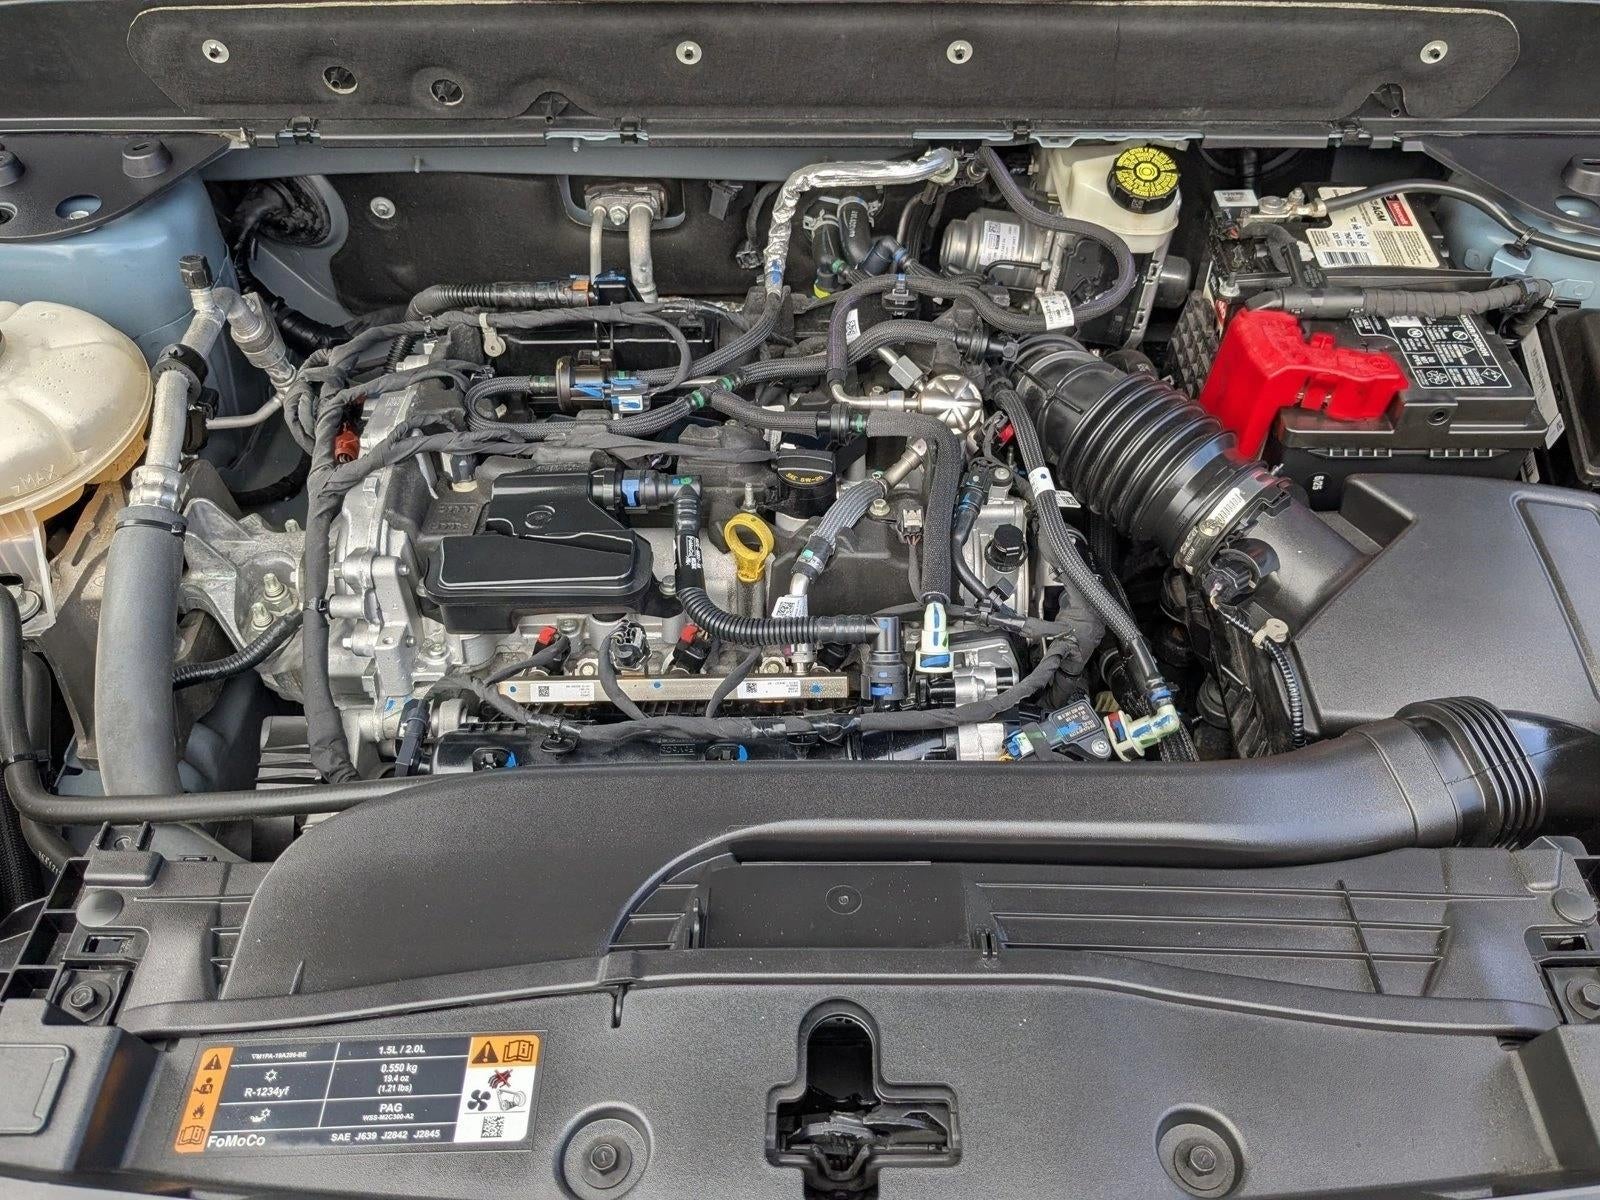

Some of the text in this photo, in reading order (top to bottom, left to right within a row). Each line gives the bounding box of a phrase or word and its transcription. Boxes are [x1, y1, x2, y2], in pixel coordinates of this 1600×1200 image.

[1371, 206, 1386, 221] AGM
[1459, 314, 1490, 356] ANGER/POISON
[378, 1045, 398, 1054] 1.5L
[405, 1044, 426, 1053] 2.0L
[380, 1063, 418, 1074] 0.550 kg
[383, 1074, 398, 1082] 19.4
[244, 1086, 290, 1098] R-1234yf
[378, 1084, 412, 1094] (1.21 lbs)
[379, 1103, 403, 1113] PAG
[207, 1133, 266, 1148] FoMoCo
[330, 1129, 441, 1141] SAE J639 J2842 J2845
